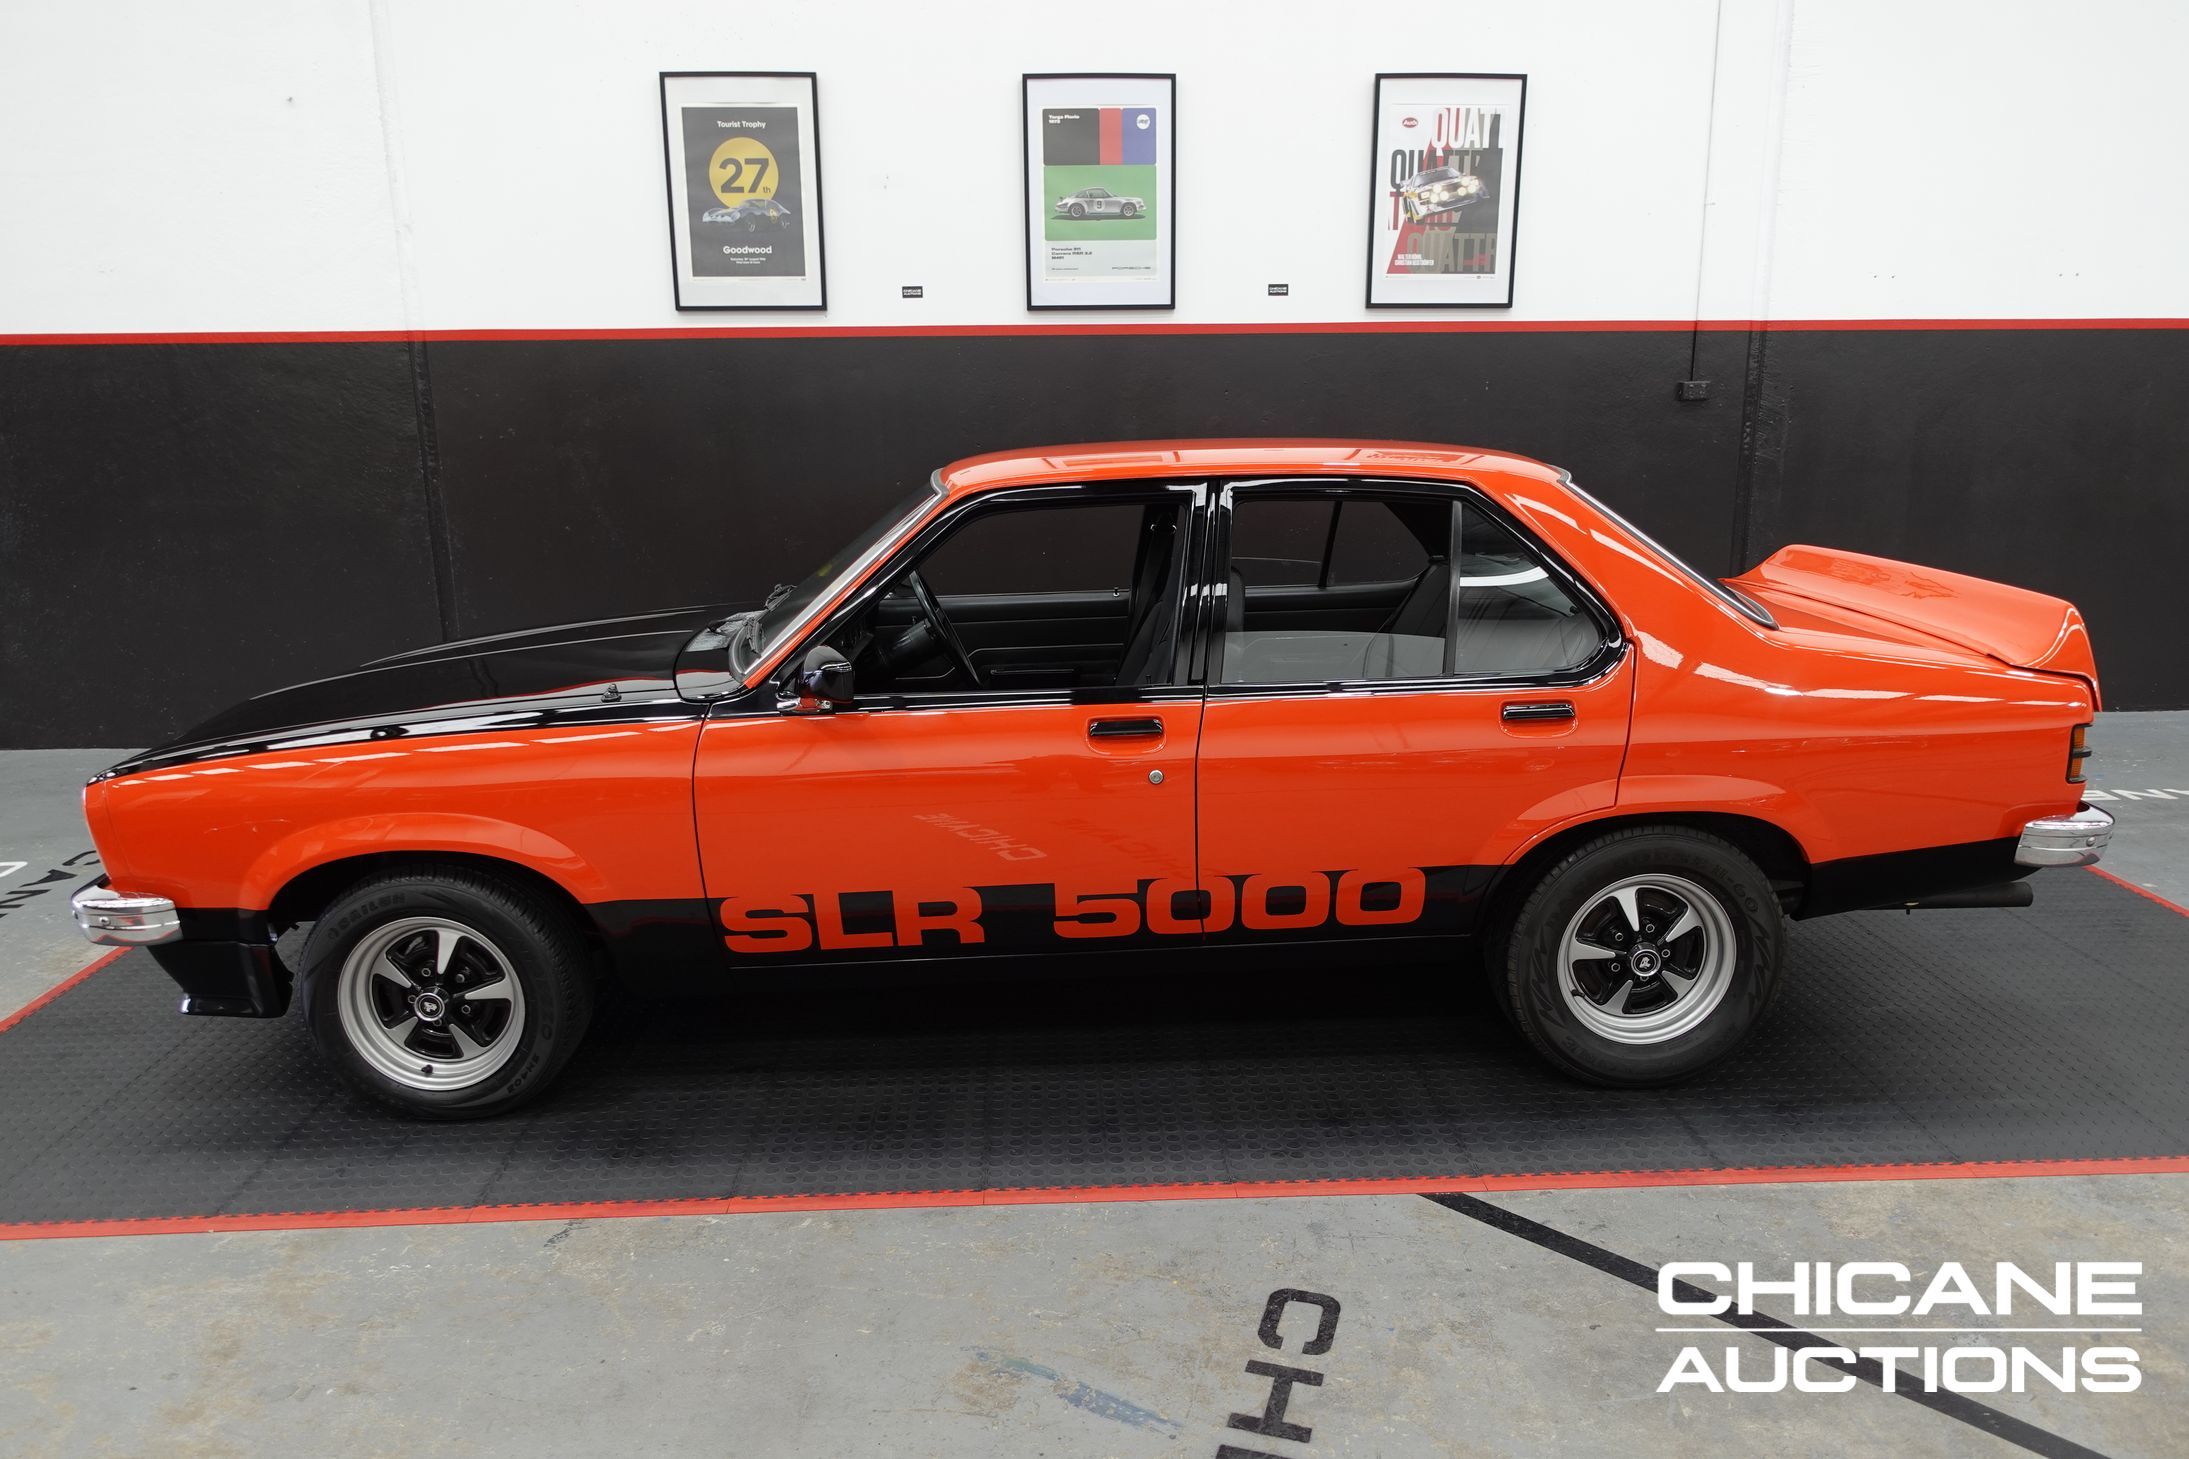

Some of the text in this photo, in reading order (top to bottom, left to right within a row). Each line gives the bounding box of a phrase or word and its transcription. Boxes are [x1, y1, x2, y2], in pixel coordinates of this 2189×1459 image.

[742, 121, 766, 129] Trophy
[719, 157, 769, 194] 27
[723, 245, 772, 254] Goodwood
[719, 866, 1426, 953] SLR 5000
